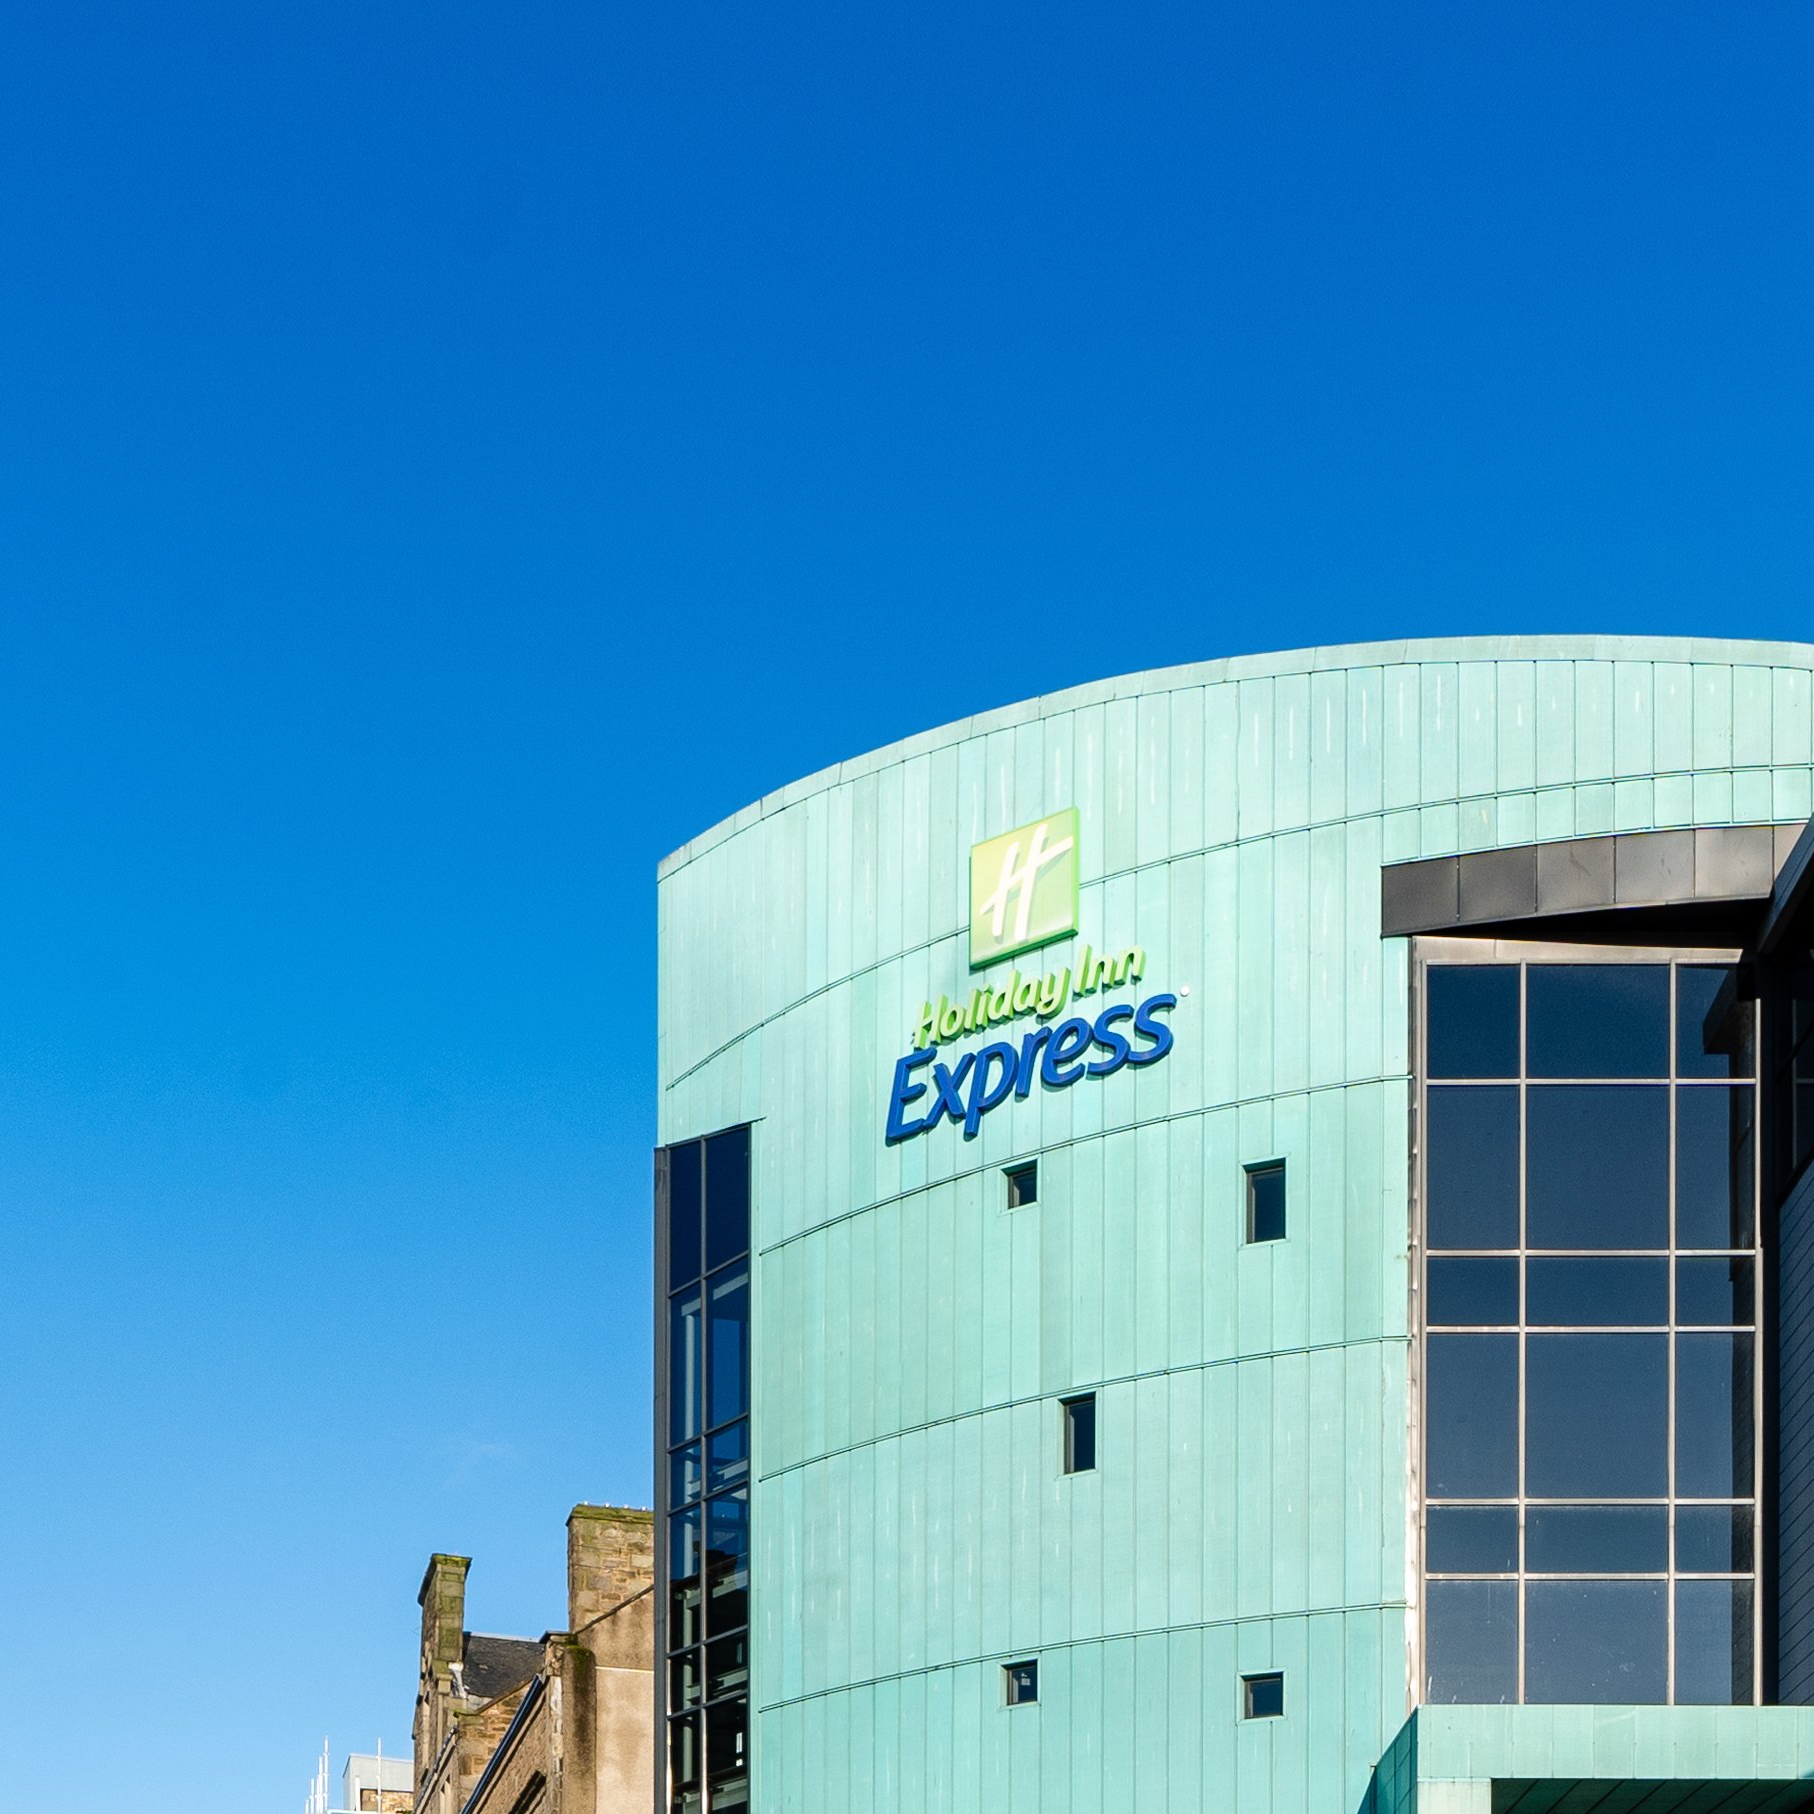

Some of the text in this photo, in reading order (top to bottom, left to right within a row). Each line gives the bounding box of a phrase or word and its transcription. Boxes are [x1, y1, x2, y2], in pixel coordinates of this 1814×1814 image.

[911, 944, 1145, 1050] Holiday Inn
[885, 992, 1178, 1147] Express
